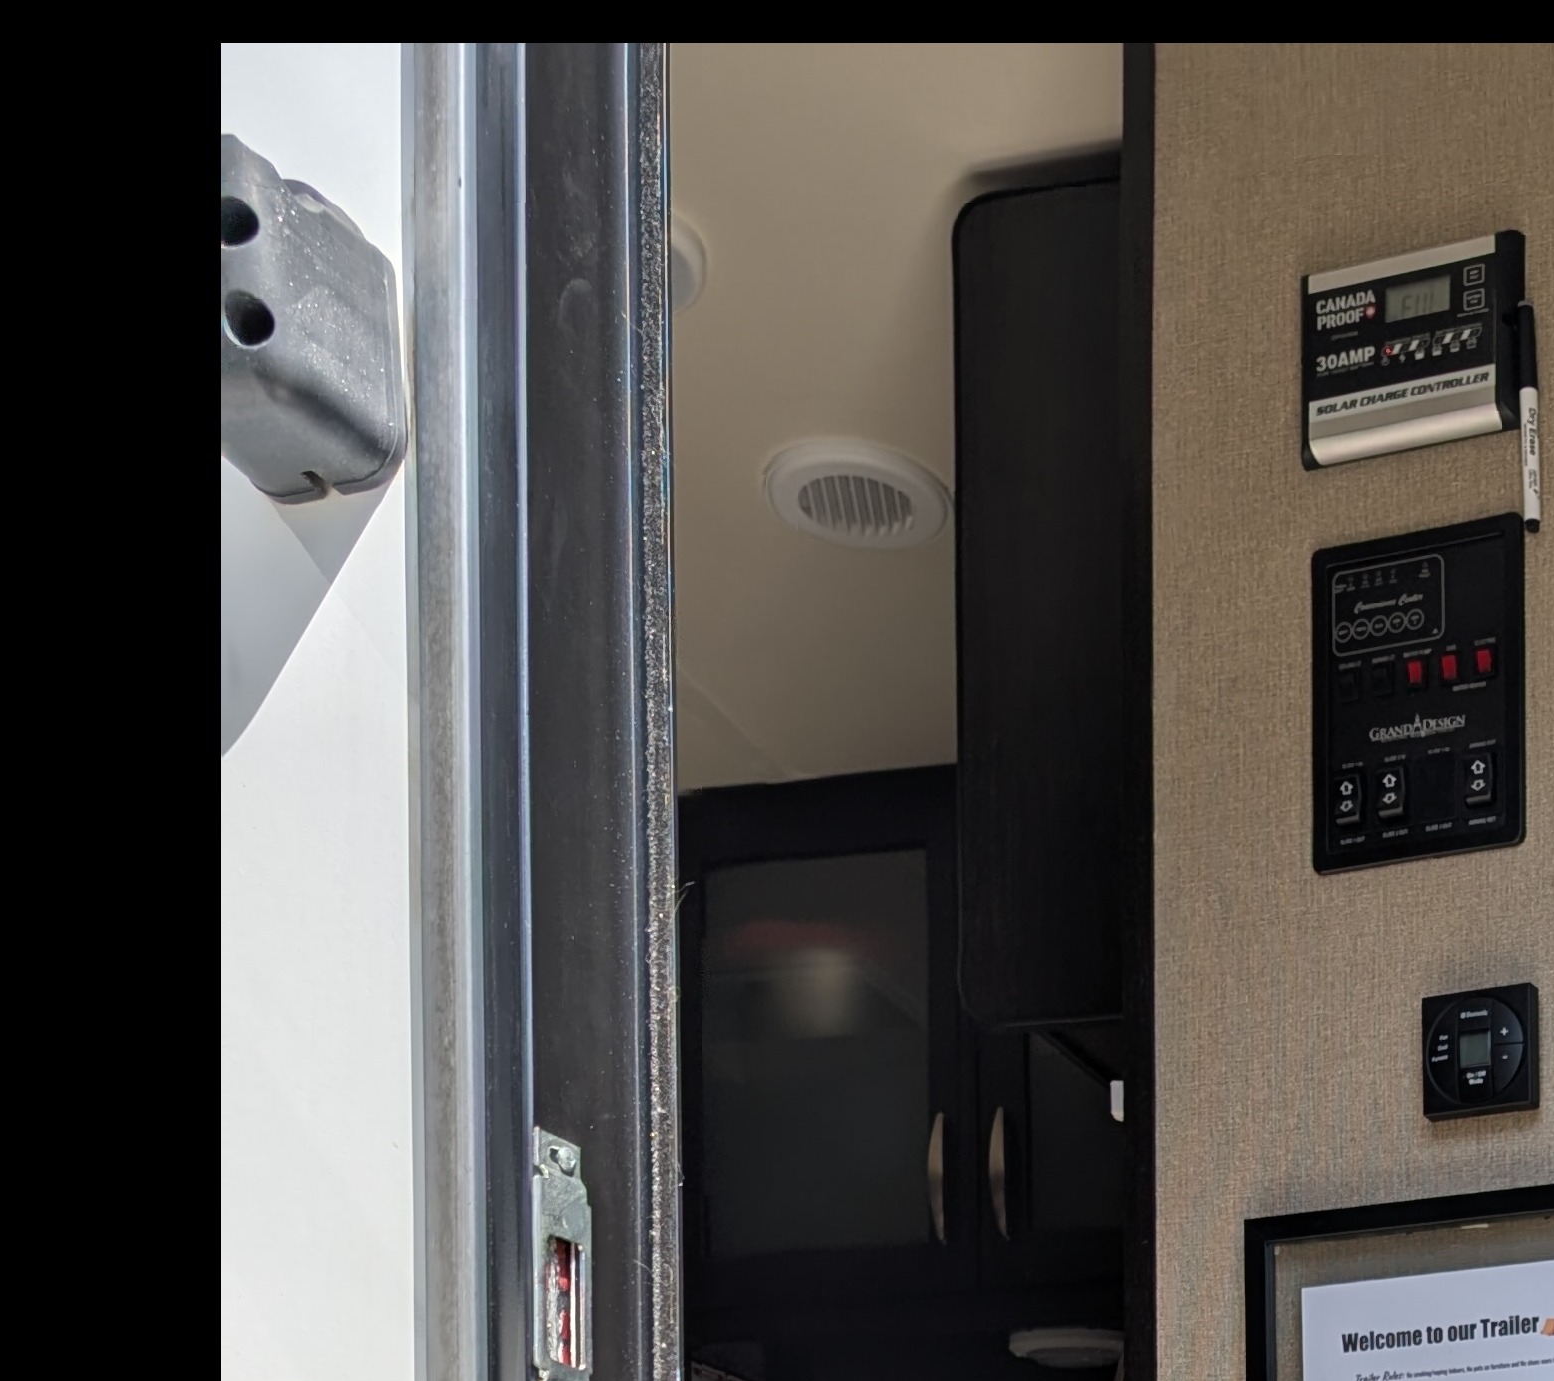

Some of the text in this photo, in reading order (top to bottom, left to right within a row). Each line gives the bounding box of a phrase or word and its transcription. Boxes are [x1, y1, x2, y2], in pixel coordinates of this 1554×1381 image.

[1316, 290, 1376, 314] CANADA
[1317, 307, 1364, 331] PROOF
[1316, 346, 1375, 372] 30AMP
[1316, 372, 1489, 416] SOLAR CHARGE CONTROLLER
[1527, 408, 1536, 425] Dry
[1369, 715, 1466, 742] GRAND DESIGN
[1342, 1315, 1540, 1353] Welcome to our Trailer
